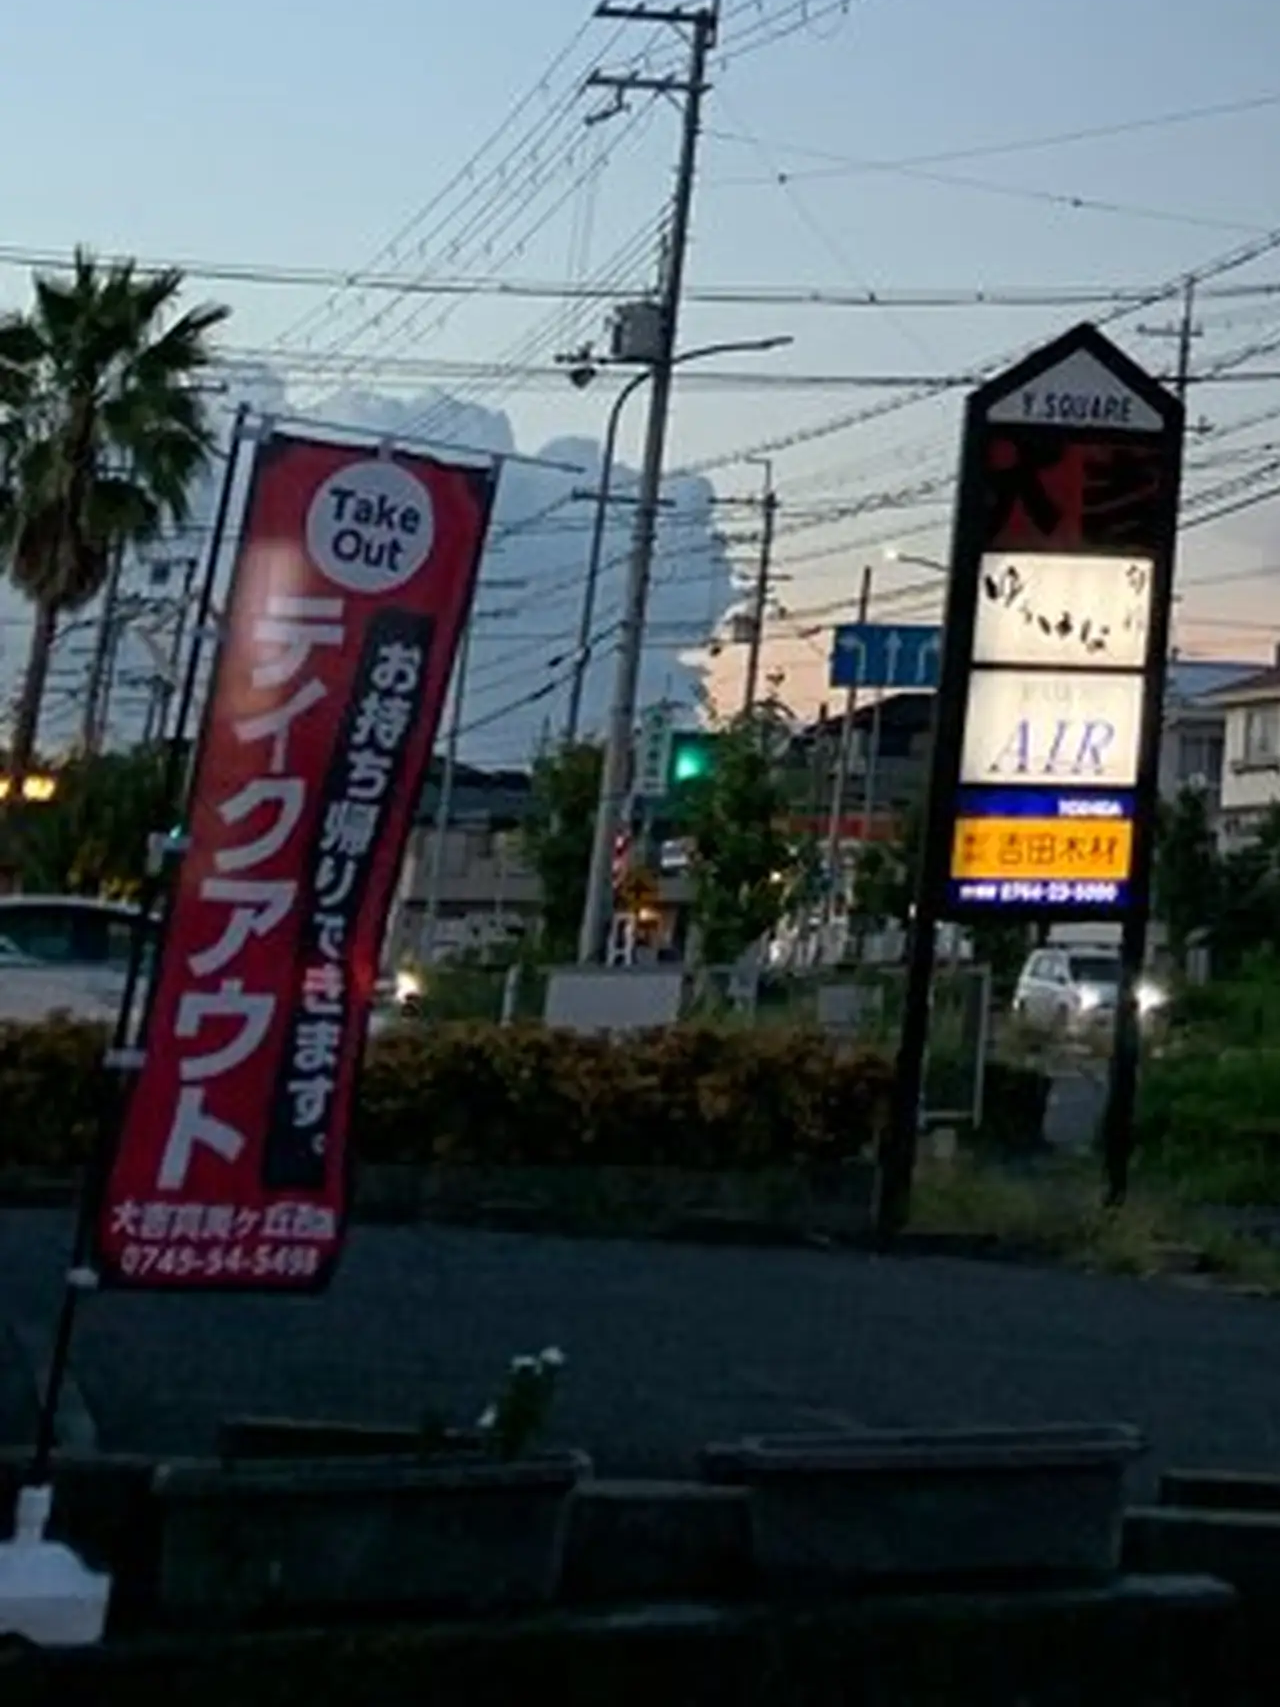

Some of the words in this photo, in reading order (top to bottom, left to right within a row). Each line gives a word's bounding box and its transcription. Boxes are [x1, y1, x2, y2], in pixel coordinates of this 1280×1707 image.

[329, 487, 421, 535] Take
[331, 527, 403, 572] Out
[987, 720, 1115, 774] AIR
[999, 834, 1117, 865] 吉田木材
[289, 641, 424, 1154] お持ち帰りできます。
